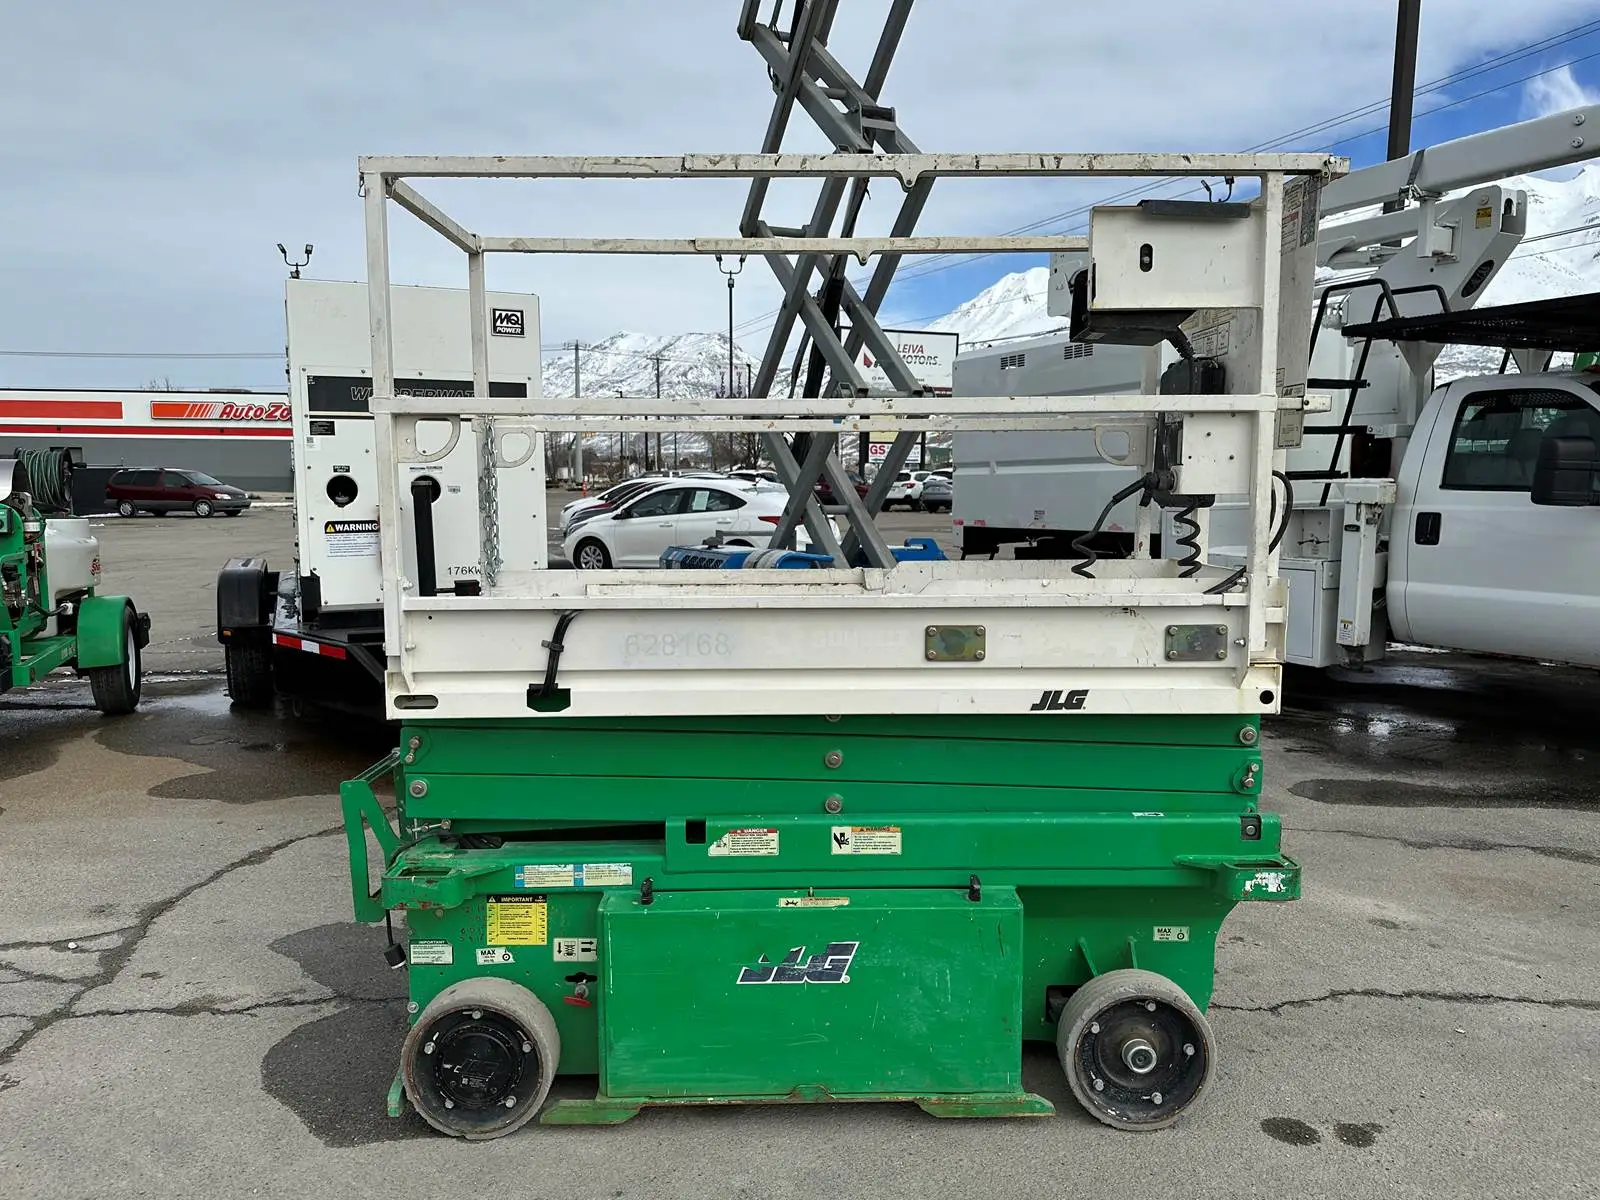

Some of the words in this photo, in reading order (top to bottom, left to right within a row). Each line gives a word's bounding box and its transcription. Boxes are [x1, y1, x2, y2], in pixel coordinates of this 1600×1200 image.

[495, 312, 522, 326] MQ
[897, 344, 925, 355] LEIVA
[335, 523, 379, 532] WARNING
[625, 632, 731, 657] 628168
[1030, 689, 1089, 711] JLG
